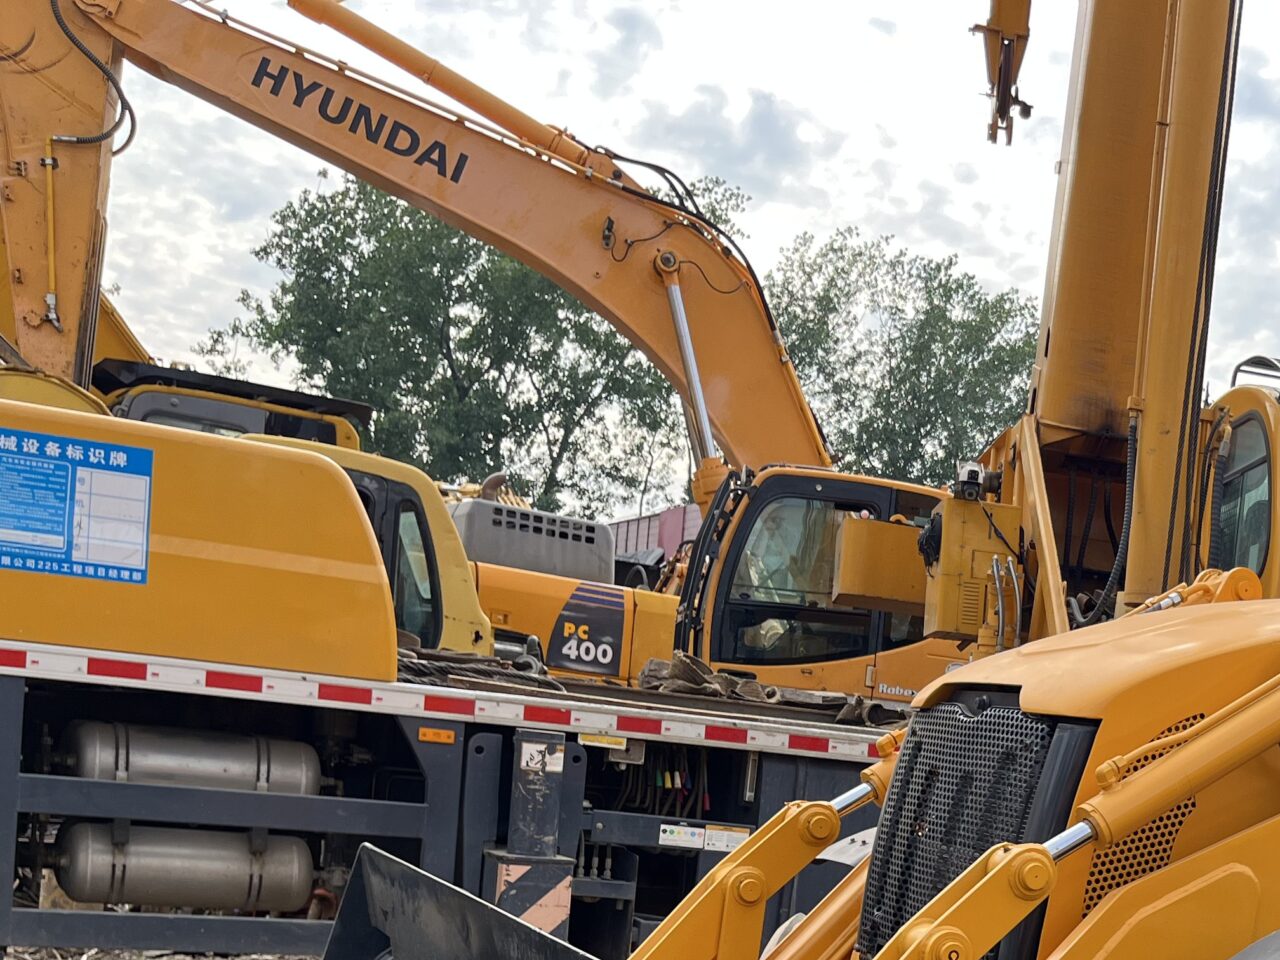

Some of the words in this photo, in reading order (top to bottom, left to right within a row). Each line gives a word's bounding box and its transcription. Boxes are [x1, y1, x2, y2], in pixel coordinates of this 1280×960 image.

[251, 56, 469, 184] HYUNDAI
[563, 621, 589, 640] PC
[561, 634, 613, 664] 400
